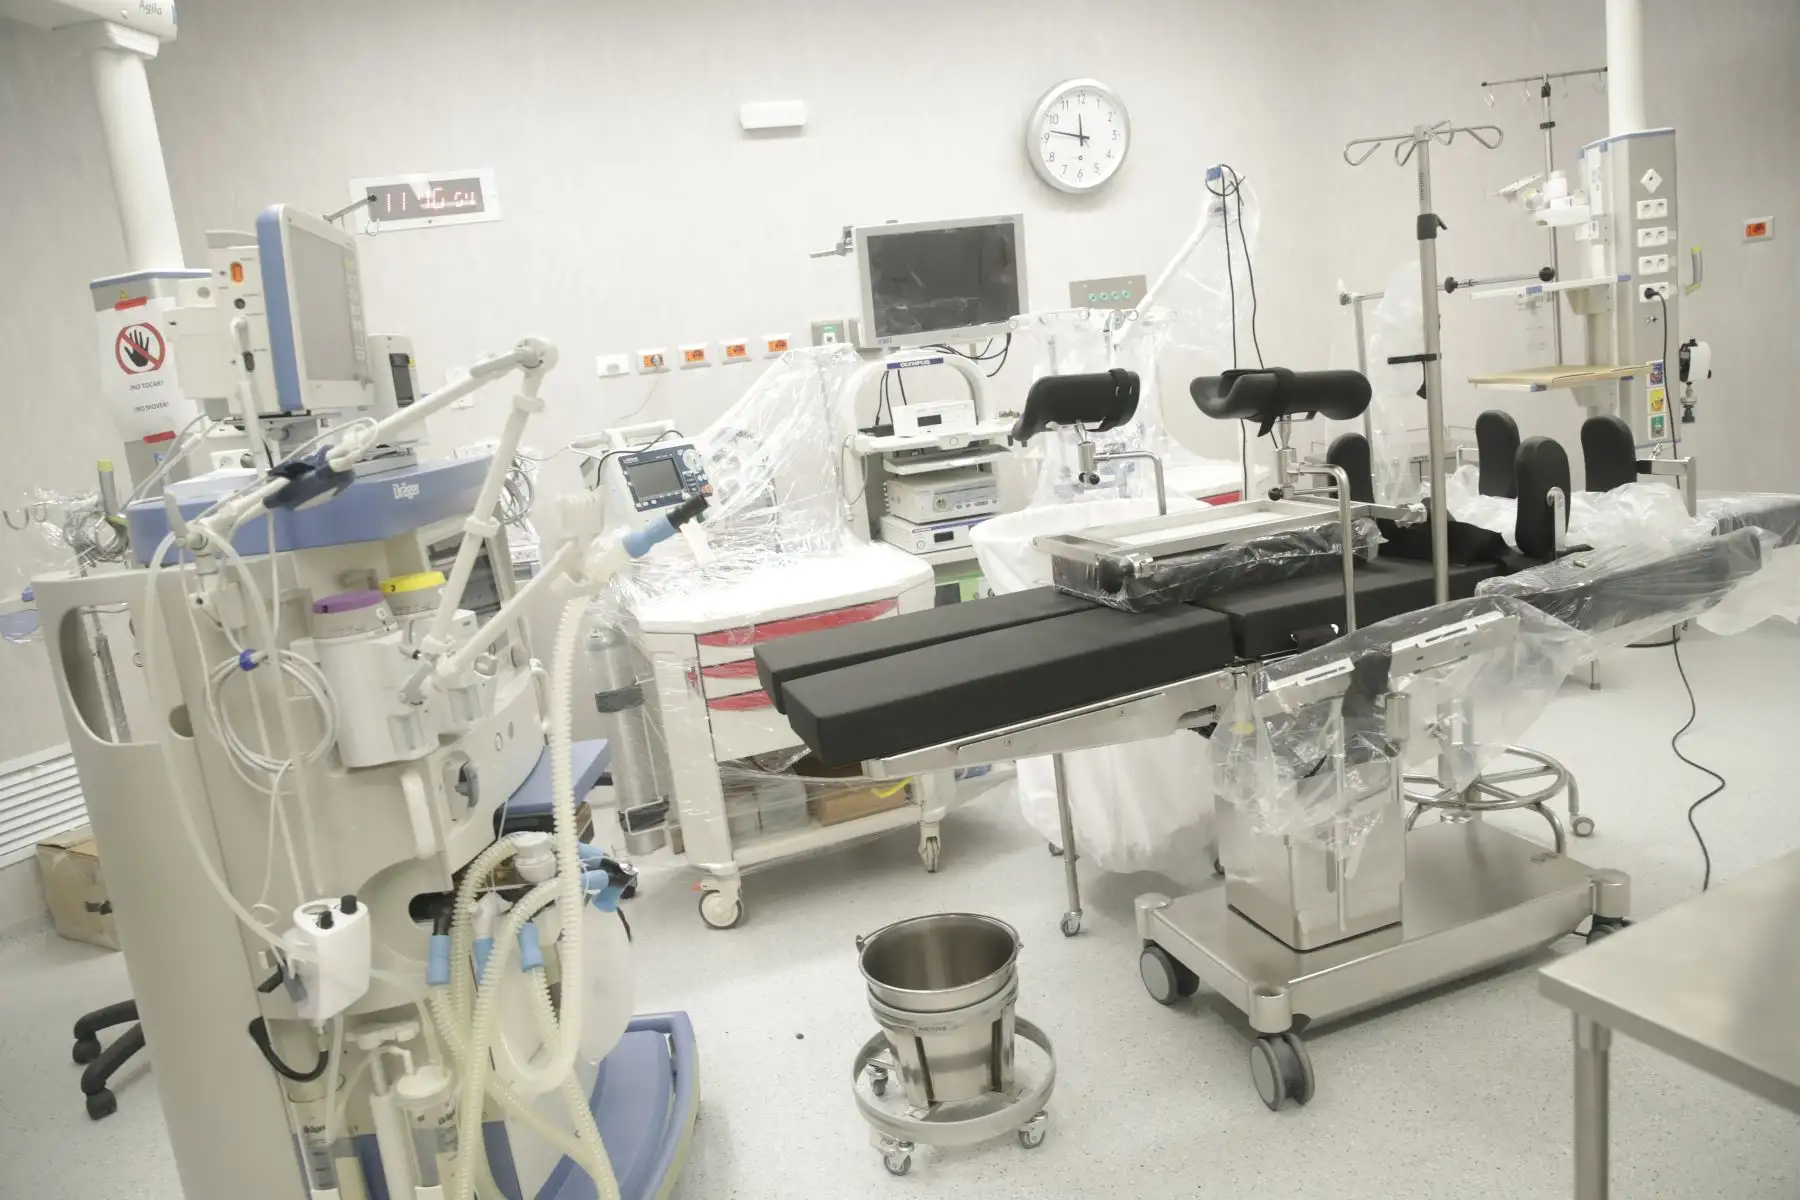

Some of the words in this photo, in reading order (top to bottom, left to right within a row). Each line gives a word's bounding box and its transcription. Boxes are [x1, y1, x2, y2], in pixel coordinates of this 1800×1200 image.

[139, 0, 163, 16] Agila
[1077, 93, 1086, 105] 12
[1061, 99, 1069, 112] 11
[1049, 114, 1059, 125] 10
[1107, 111, 1113, 122] 2
[1043, 132, 1050, 143] 9
[1111, 129, 1118, 141] 3
[1049, 152, 1055, 163] 8
[1105, 148, 1112, 160] 4
[1061, 164, 1068, 176] 7
[1077, 169, 1083, 179] 6
[1094, 162, 1100, 174] 5
[900, 360, 931, 369] OLYMPUS
